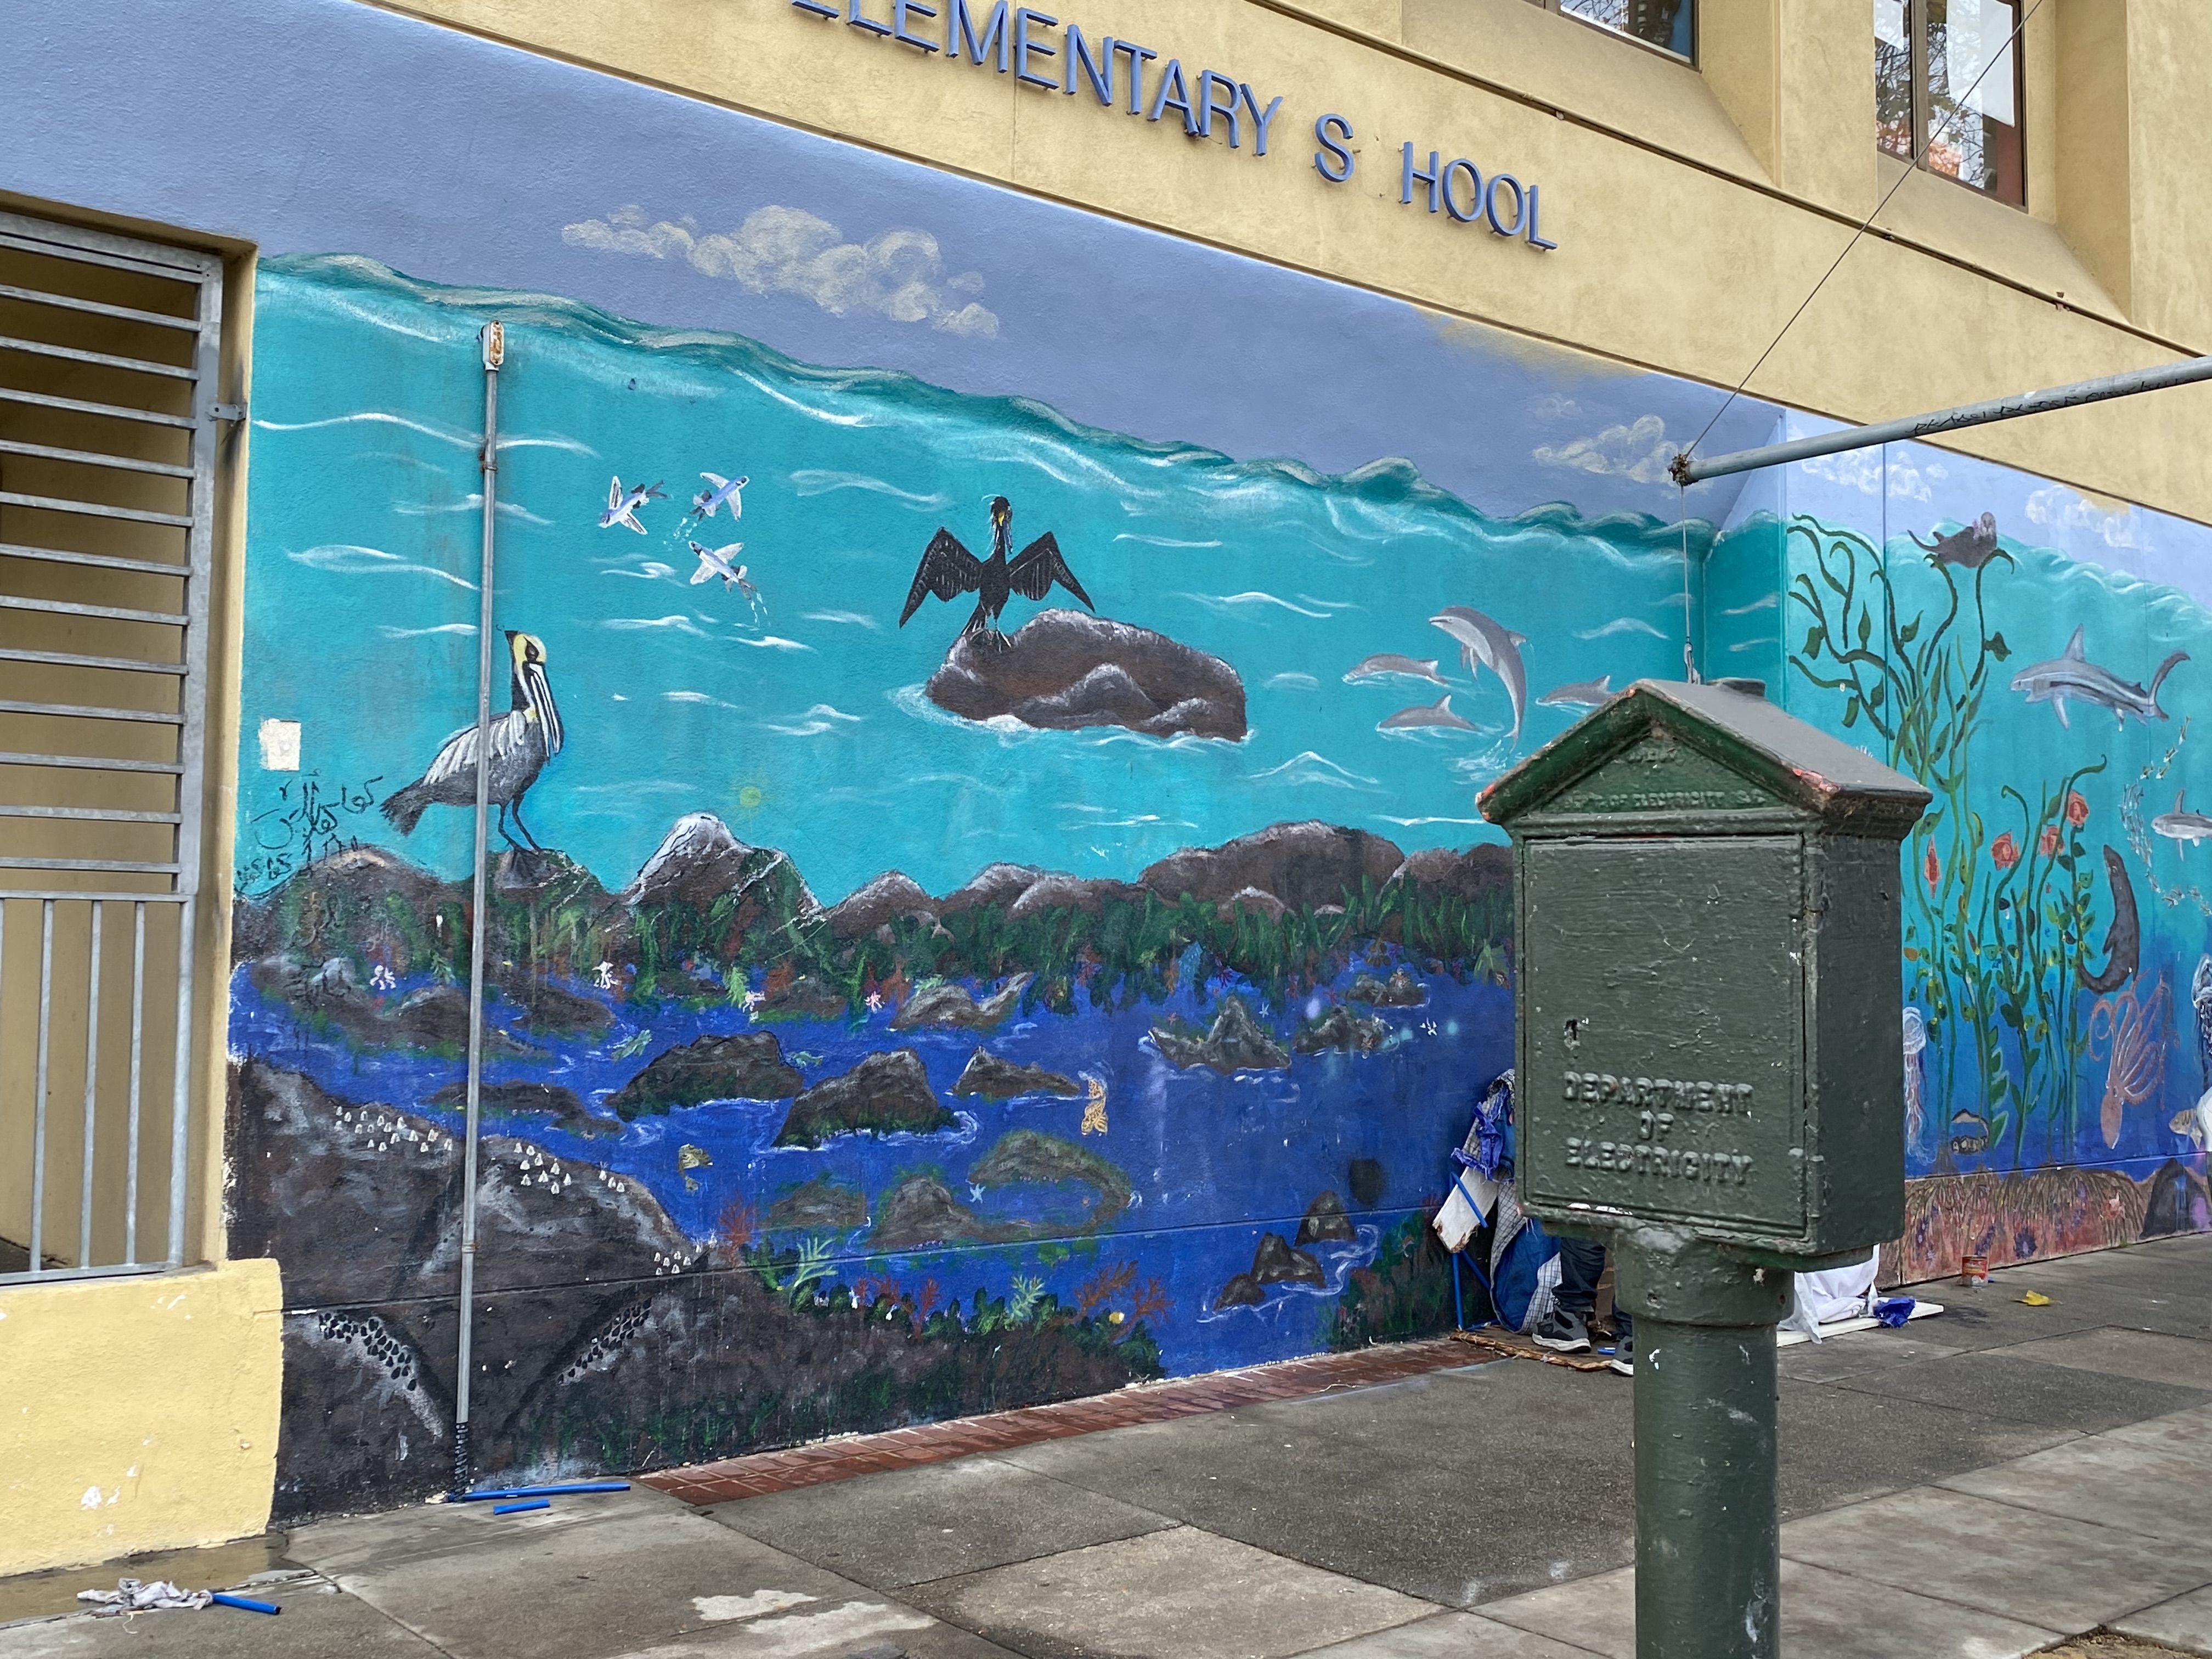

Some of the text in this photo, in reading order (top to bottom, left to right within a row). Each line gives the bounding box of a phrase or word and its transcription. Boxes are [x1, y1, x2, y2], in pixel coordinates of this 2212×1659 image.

[1563, 1071, 1754, 1115] DEPARTMENT
[1639, 1110, 1675, 1143] OF
[1565, 1137, 1754, 1185] ELECTRICITY
